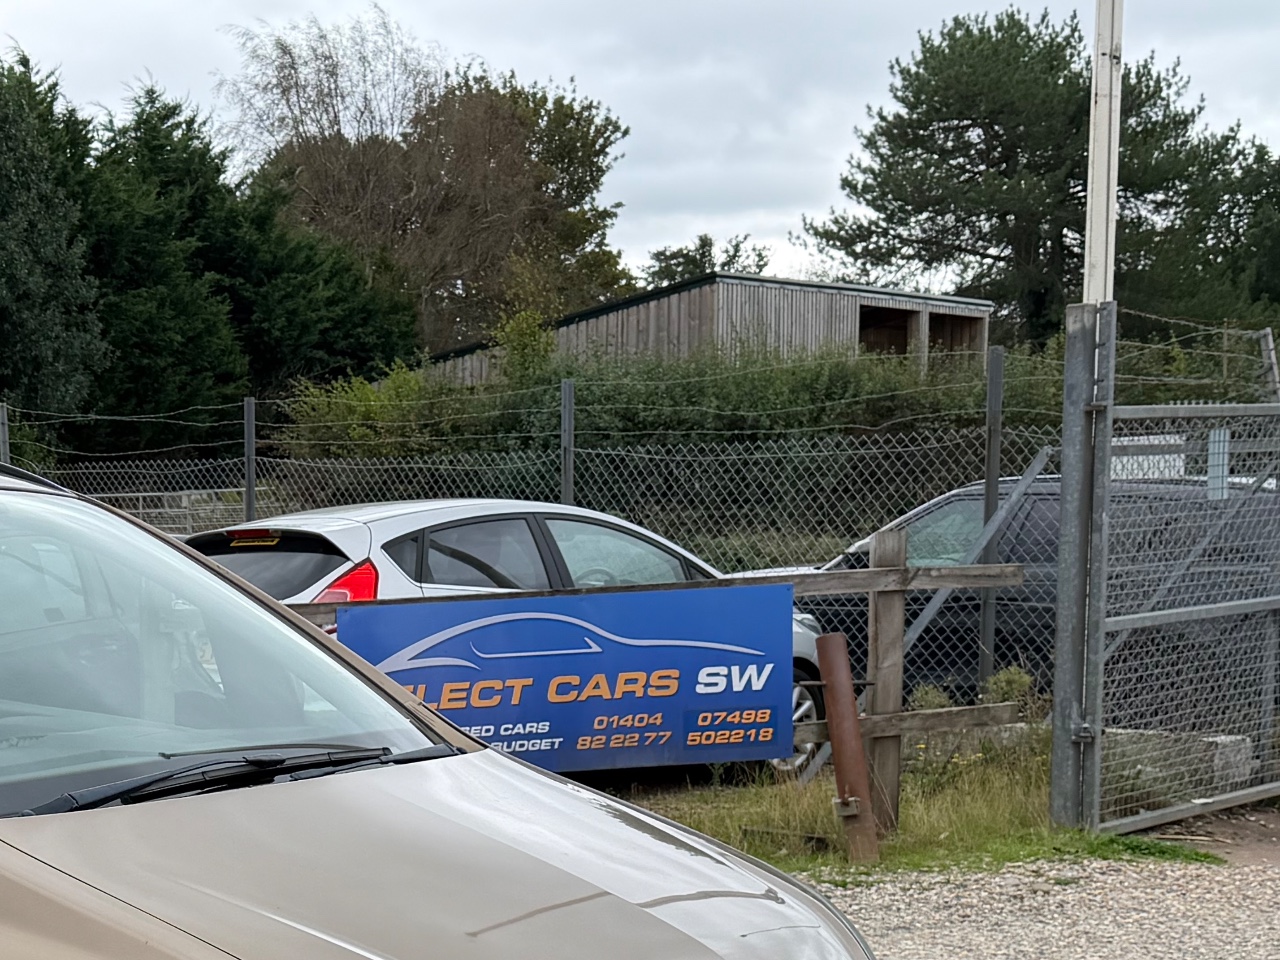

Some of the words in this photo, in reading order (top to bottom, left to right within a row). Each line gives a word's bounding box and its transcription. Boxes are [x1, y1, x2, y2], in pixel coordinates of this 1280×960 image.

[403, 677, 534, 710] LECT
[547, 668, 680, 704] CARS
[695, 663, 775, 694] SW
[593, 712, 664, 730] 01404
[697, 709, 772, 727] 07498
[499, 722, 550, 736] CARS
[686, 727, 774, 746] 502218
[576, 735, 607, 750] 82
[609, 732, 640, 748] 22
[643, 731, 672, 746] 77
